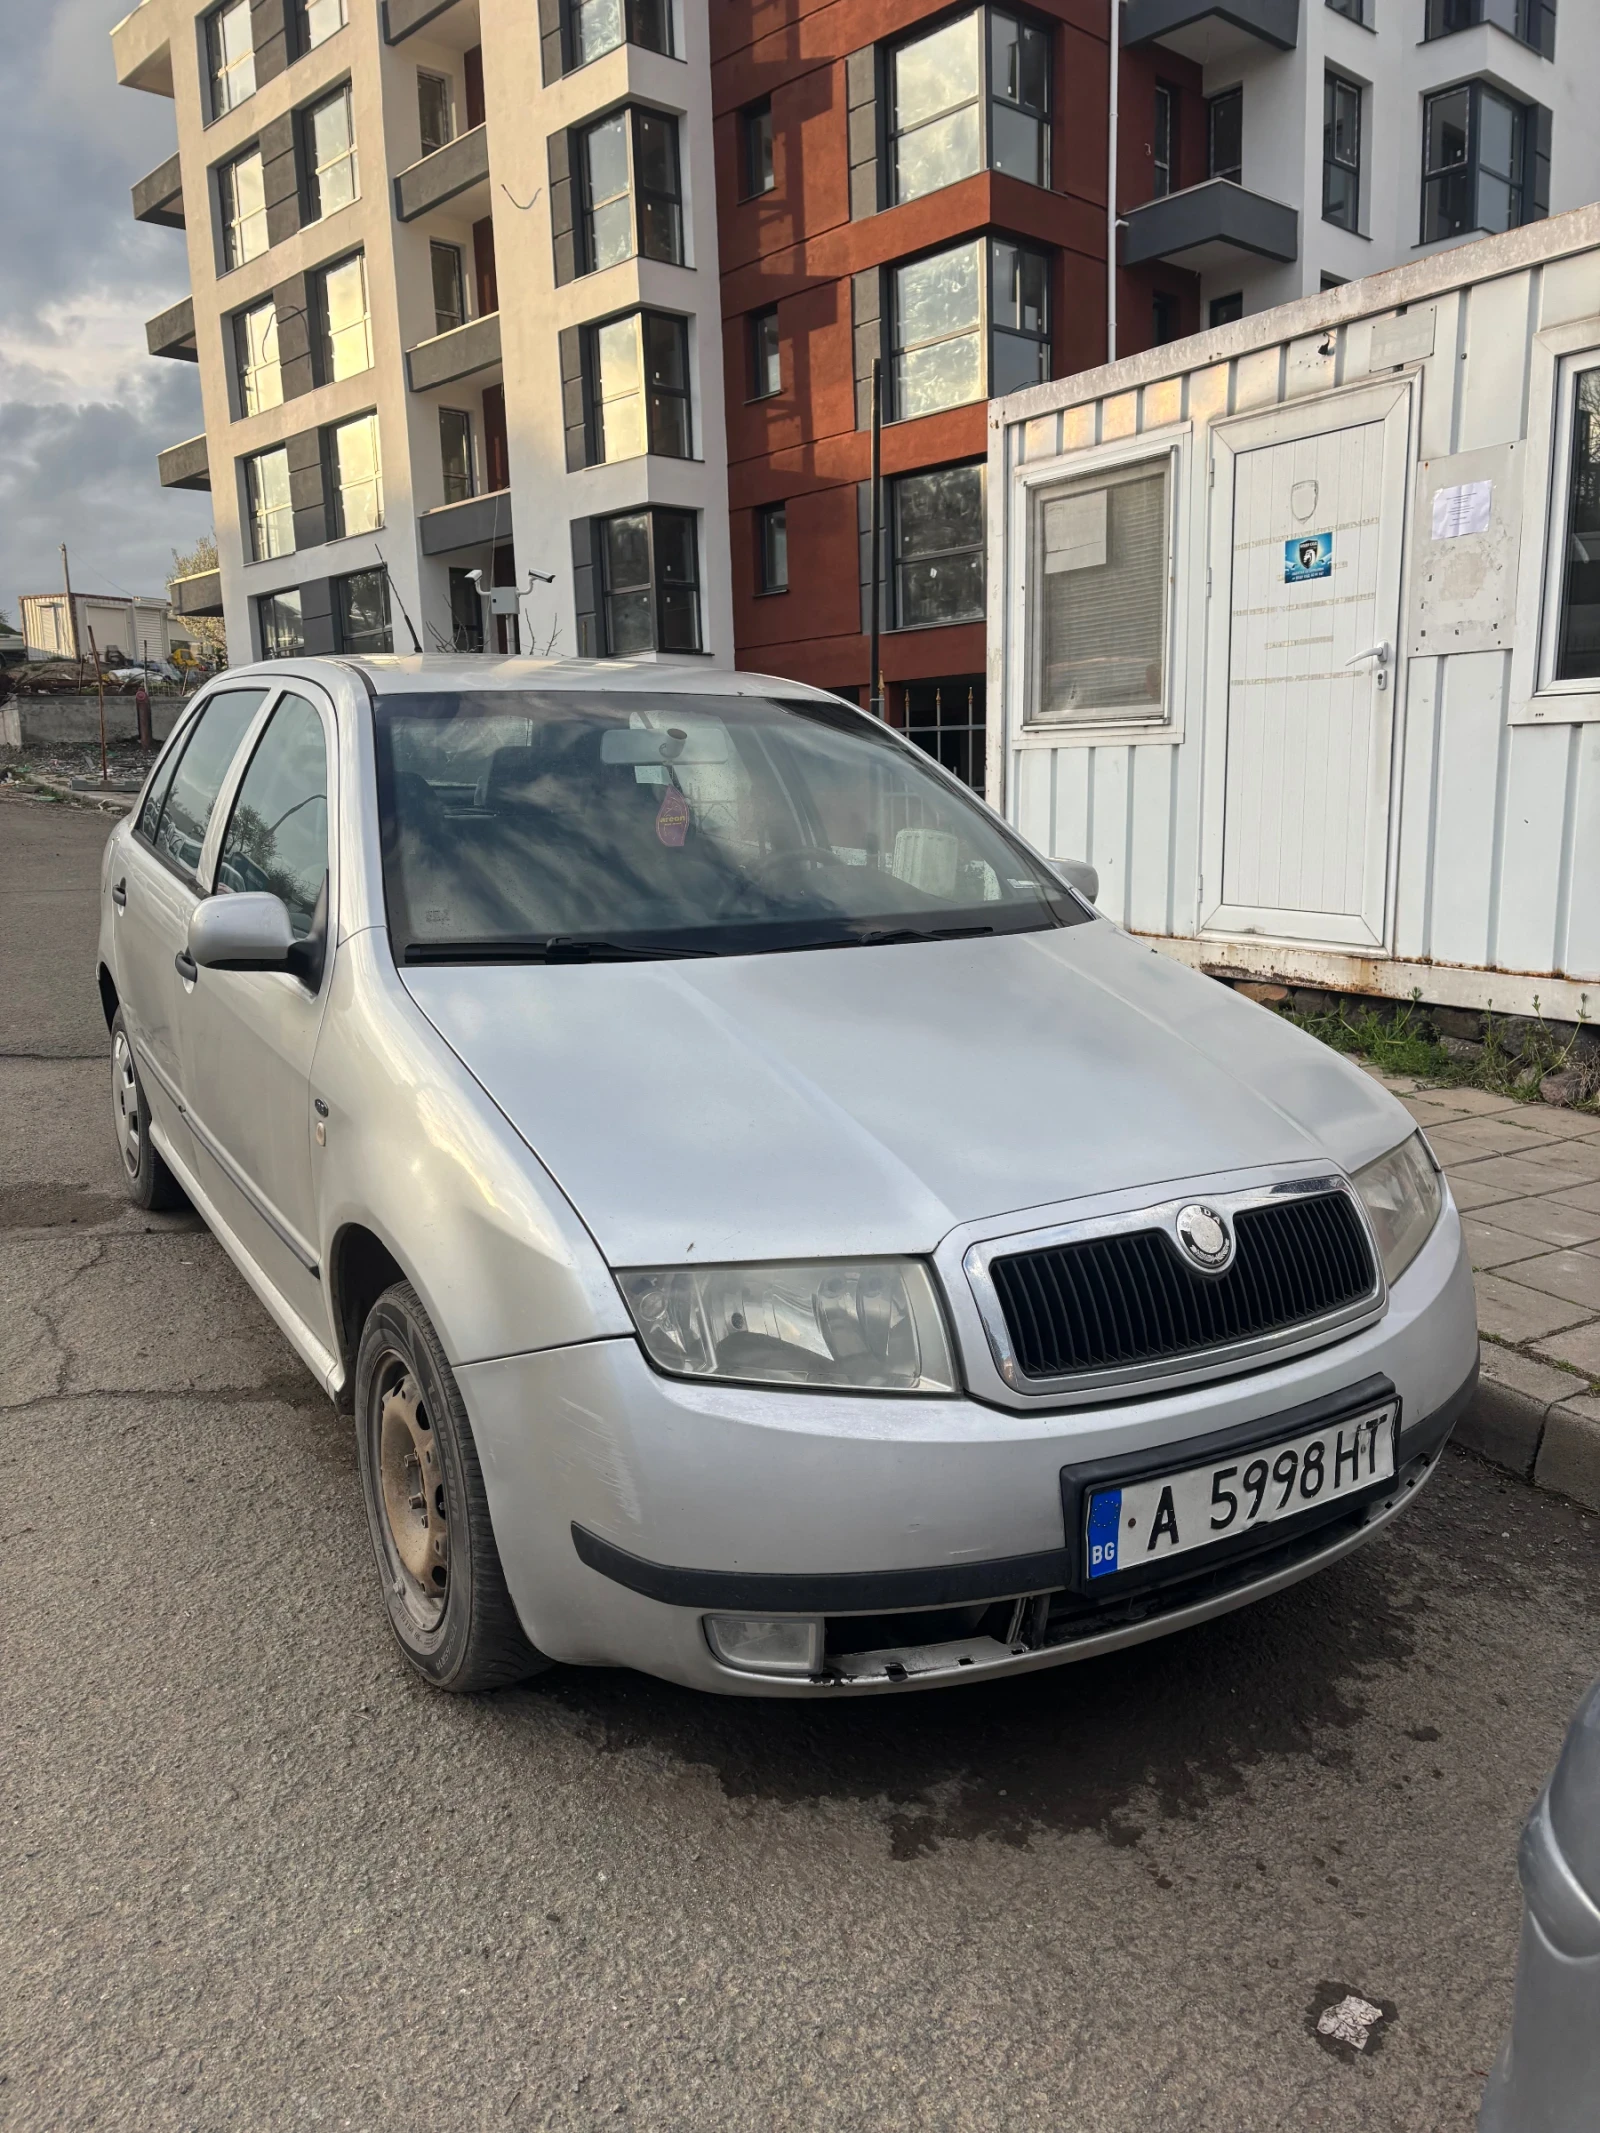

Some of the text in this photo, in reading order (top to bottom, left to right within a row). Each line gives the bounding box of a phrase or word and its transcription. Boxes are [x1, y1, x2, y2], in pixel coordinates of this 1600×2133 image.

[660, 815, 685, 823] areon
[1147, 1413, 1388, 1551] A 5998 HT
[1092, 1542, 1115, 1565] BG
